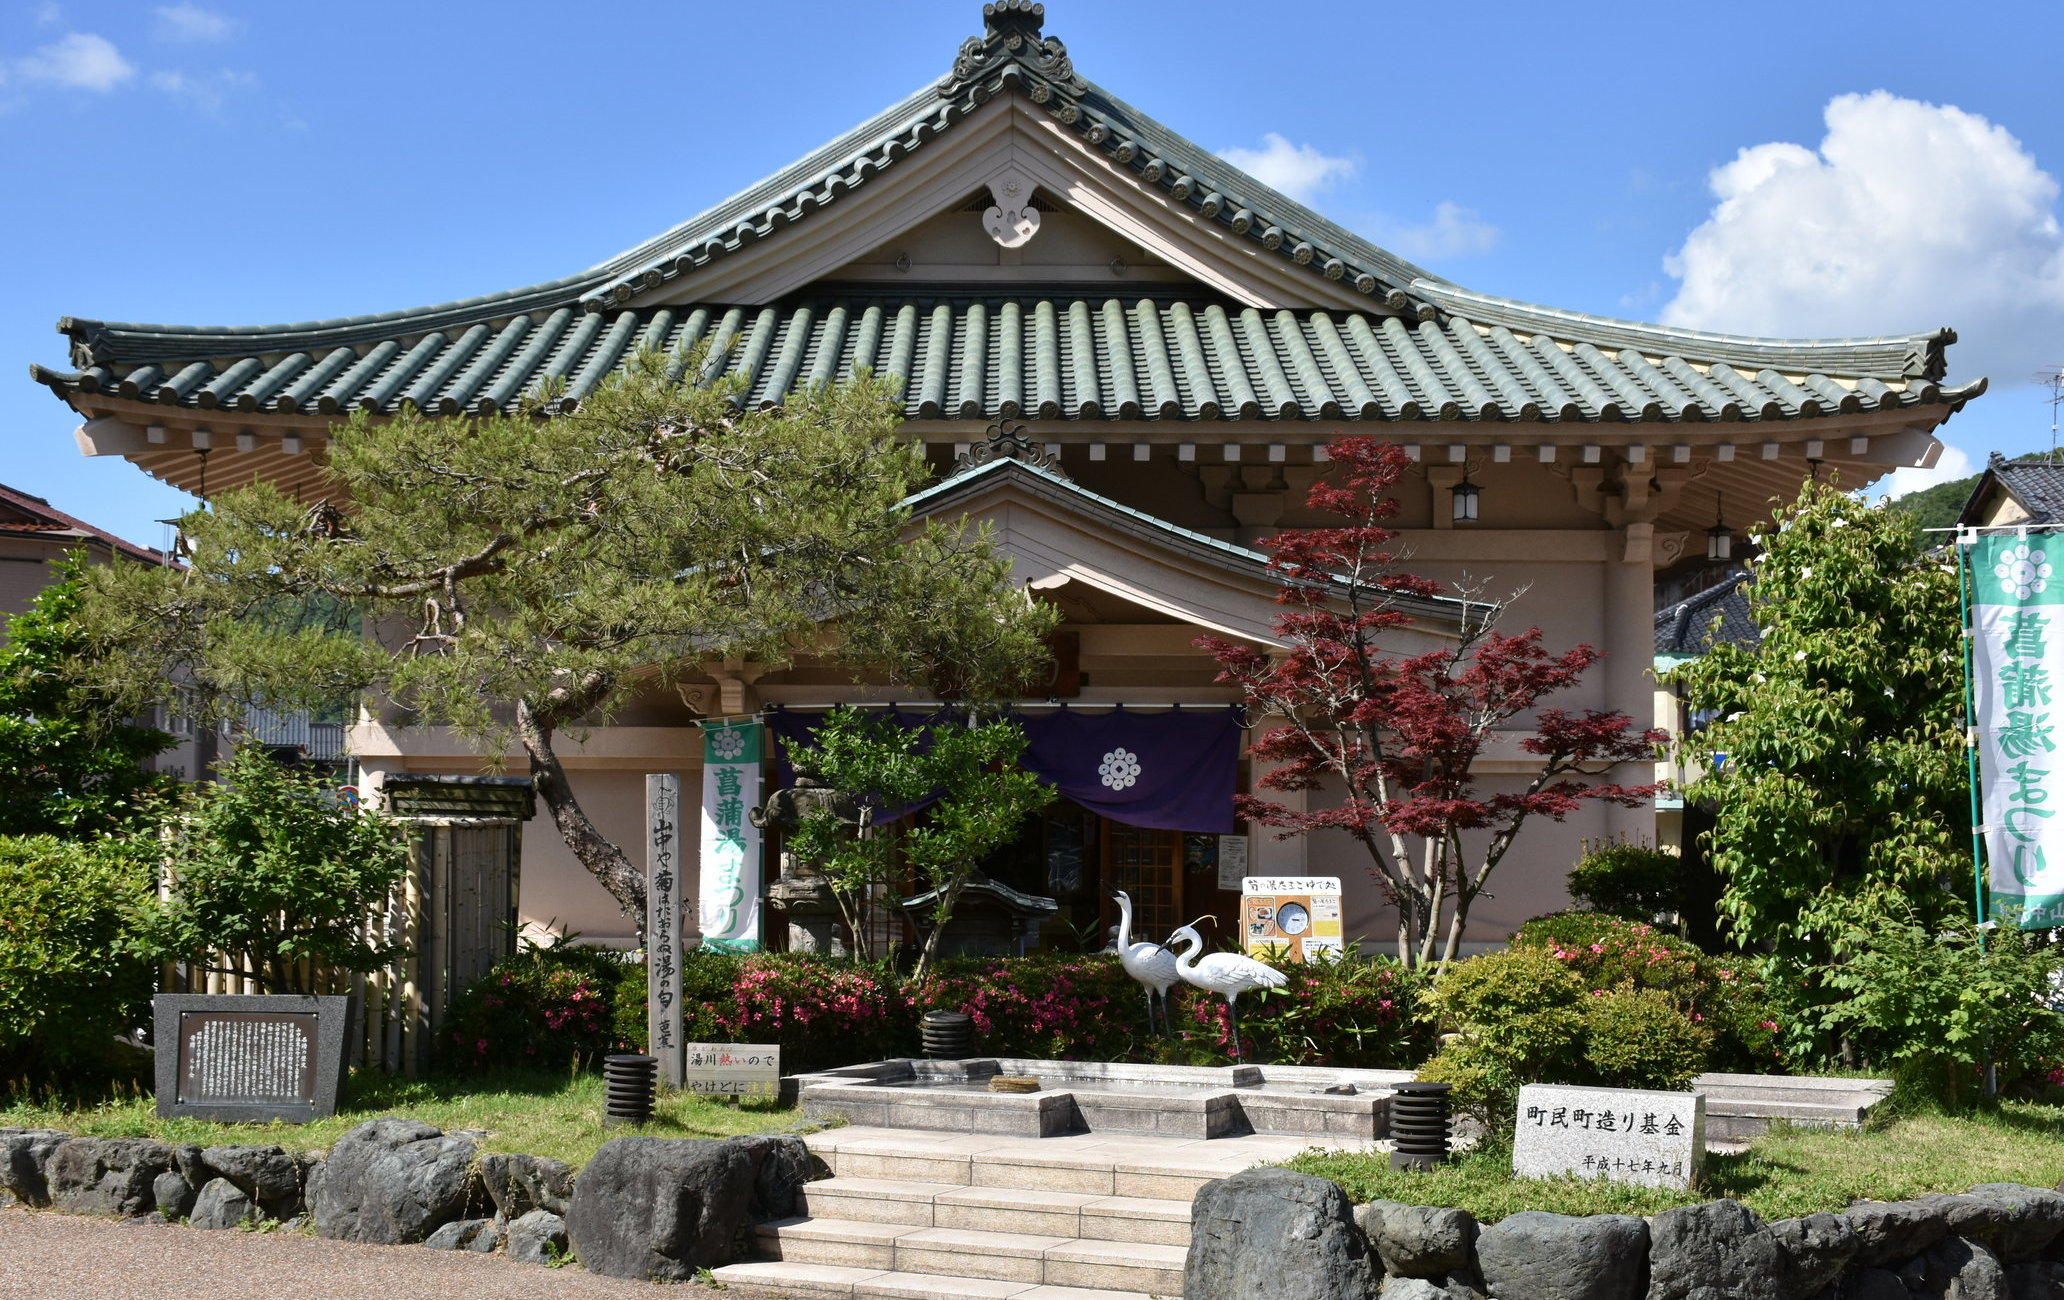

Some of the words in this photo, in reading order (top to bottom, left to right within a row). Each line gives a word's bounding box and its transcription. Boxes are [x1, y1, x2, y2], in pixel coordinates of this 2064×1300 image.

[713, 766, 748, 935] 菖蒲湯まつり
[690, 1052, 775, 1067] 湯川熱いので
[690, 1080, 774, 1094] やけどに注意
[1526, 1106, 1686, 1136] 町民町造り基金
[1581, 1155, 1683, 1176] 平成十七年九月
